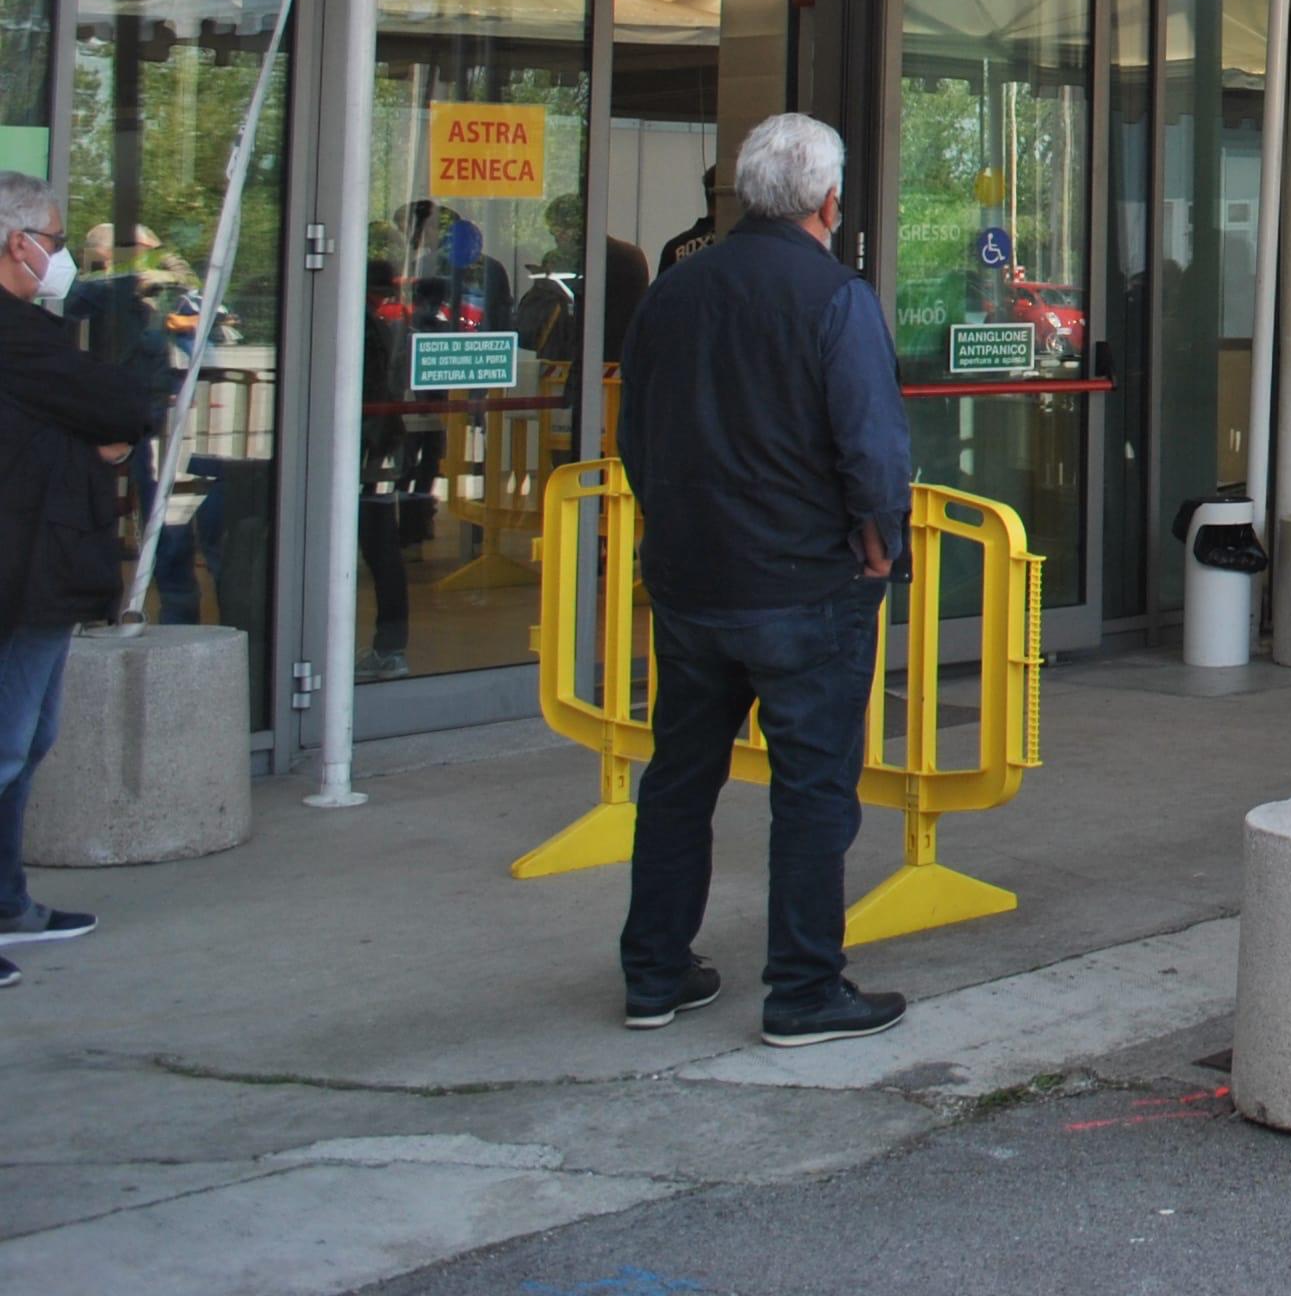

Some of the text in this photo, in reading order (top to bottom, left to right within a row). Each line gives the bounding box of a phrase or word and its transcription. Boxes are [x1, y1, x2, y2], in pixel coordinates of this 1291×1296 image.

[448, 120, 528, 144] ASTRA
[440, 158, 535, 182] ZENECA
[958, 331, 1028, 342] MANIGLIONE
[419, 340, 511, 352] USCITA DI SICUREZZA
[959, 344, 1027, 356] ANTIPANICO
[421, 357, 437, 365] NON
[475, 355, 485, 364] LA
[421, 369, 507, 381] APERTURA A SPINTA
